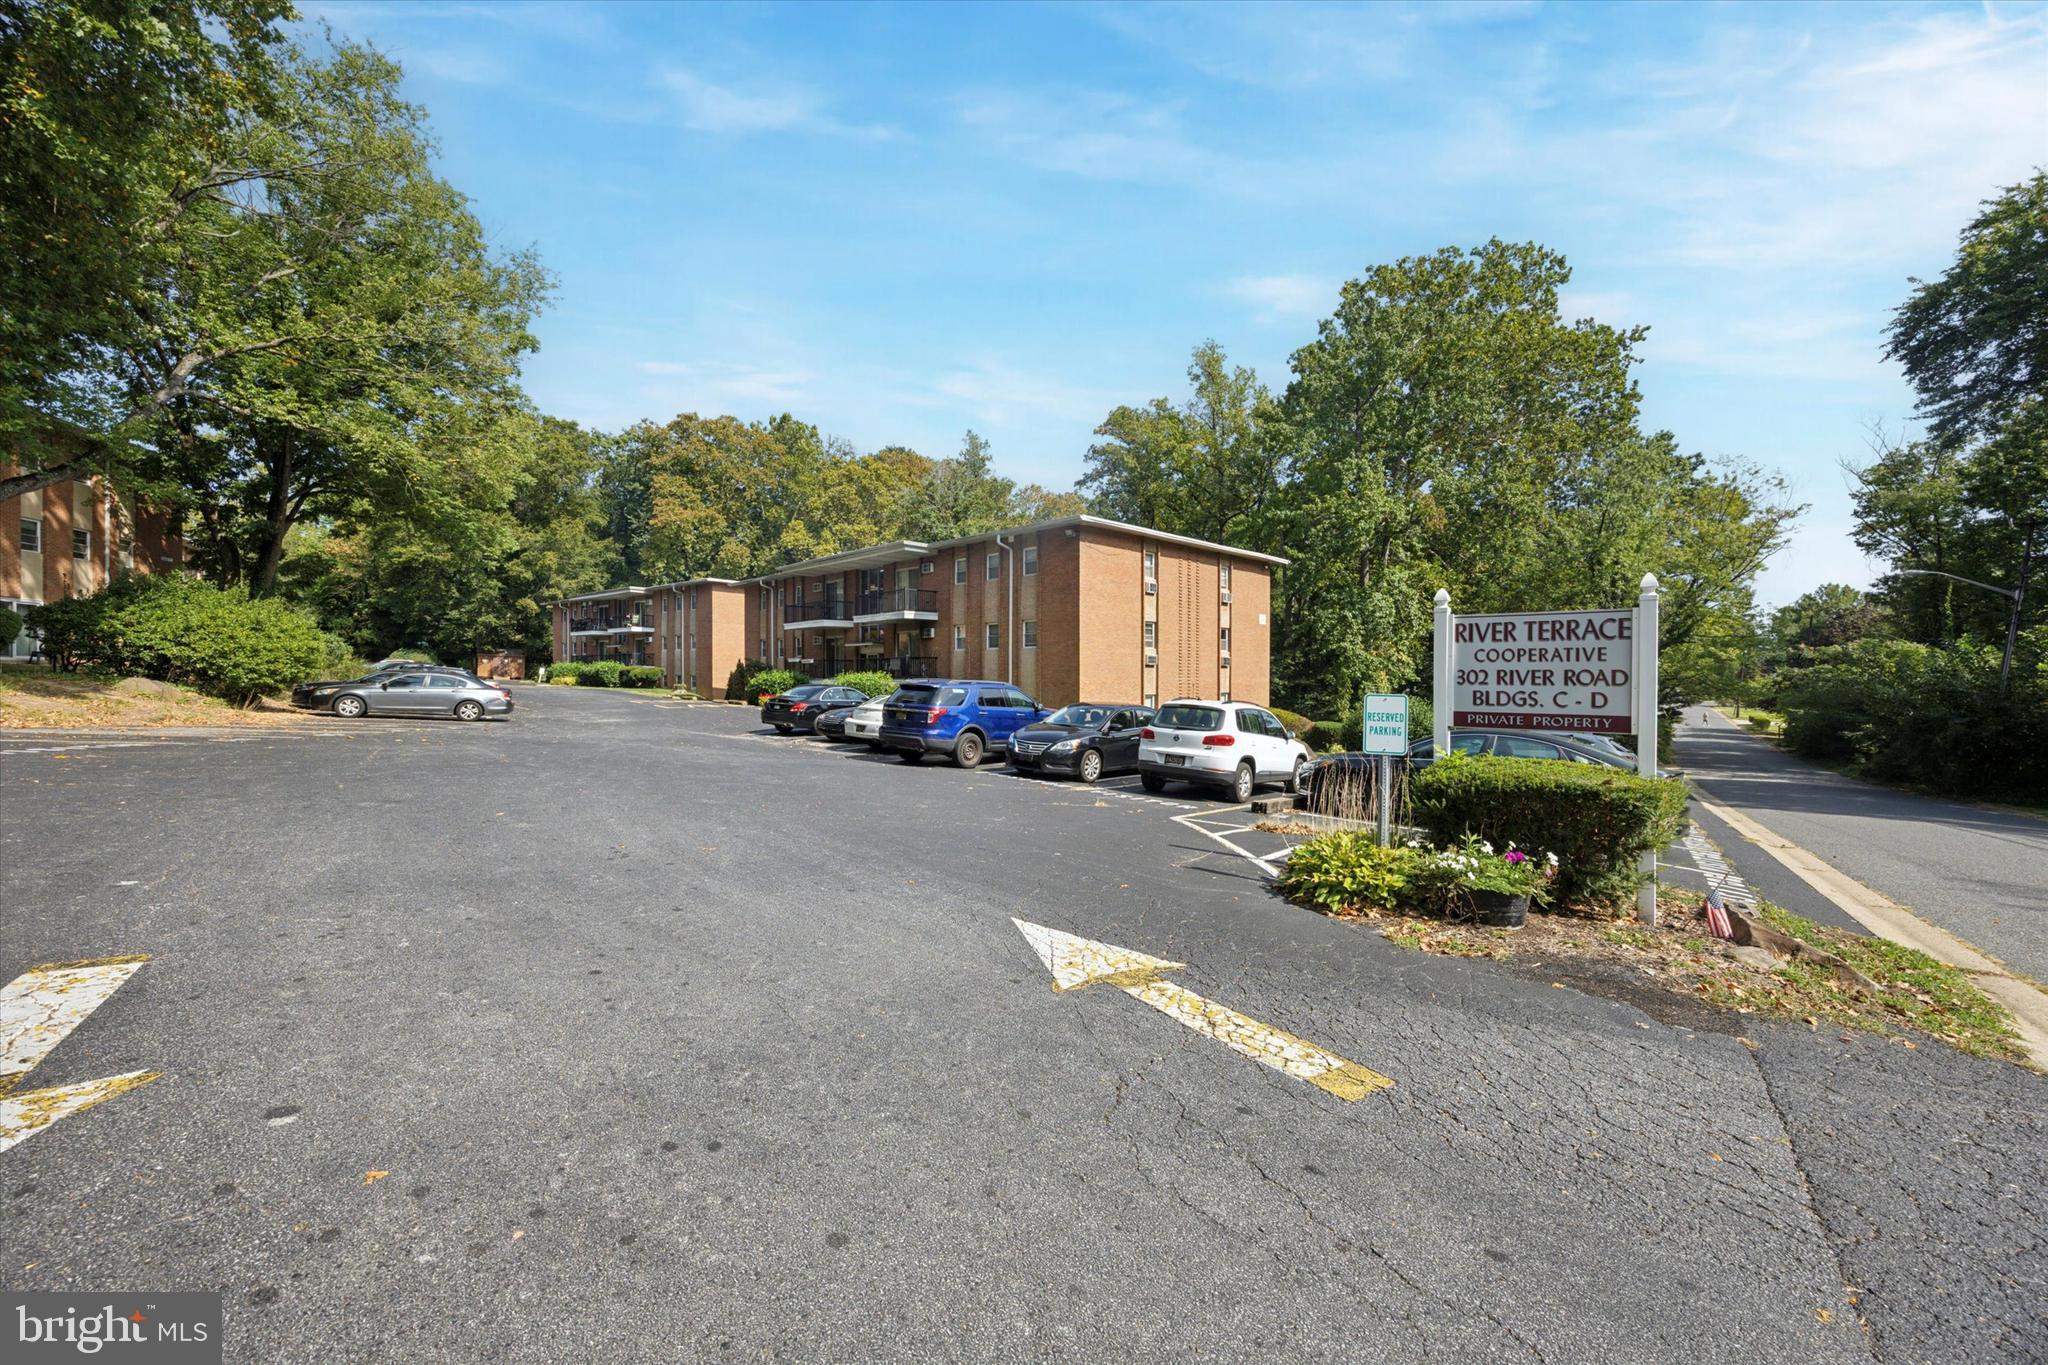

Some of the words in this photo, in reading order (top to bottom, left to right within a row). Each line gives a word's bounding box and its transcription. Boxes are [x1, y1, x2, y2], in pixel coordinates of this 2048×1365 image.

[1455, 622, 1517, 643] RIVER
[1524, 617, 1632, 641] TERRACE
[1474, 647, 1607, 663] COOPERATIVE
[1456, 669, 1488, 686] 302
[1496, 669, 1554, 686] RIVER
[1564, 669, 1629, 687] ROAD
[1472, 690, 1544, 708] BLDGS.
[1552, 691, 1568, 708] C
[1591, 692, 1608, 709] D
[1367, 712, 1404, 722] RESERVED
[1467, 714, 1524, 725] PRIVATE
[1533, 716, 1612, 728] PROPERTY
[1369, 726, 1402, 736] PARKING
